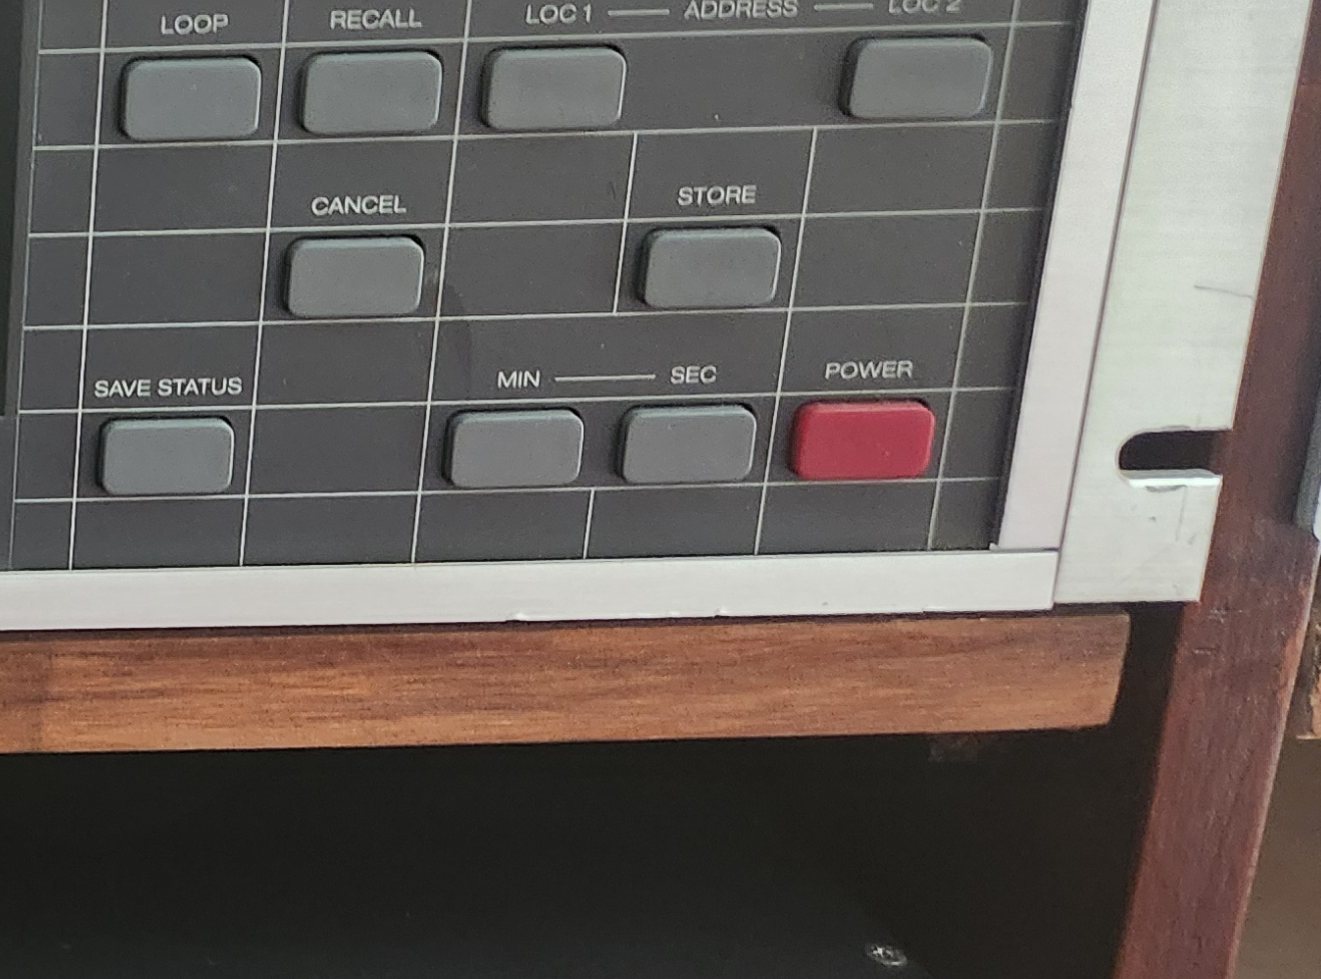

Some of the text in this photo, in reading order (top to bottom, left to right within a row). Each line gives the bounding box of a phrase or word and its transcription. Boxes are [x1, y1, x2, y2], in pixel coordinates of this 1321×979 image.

[160, 13, 229, 35] LOOP
[330, 8, 423, 30] RECALL
[525, 3, 577, 24] LOC
[311, 194, 407, 216] CANCEL
[677, 185, 757, 206] STORE
[497, 370, 541, 388] MIN
[670, 365, 717, 385] SEC
[824, 360, 913, 380] POWER
[94, 376, 242, 398] SAVE STATUS
